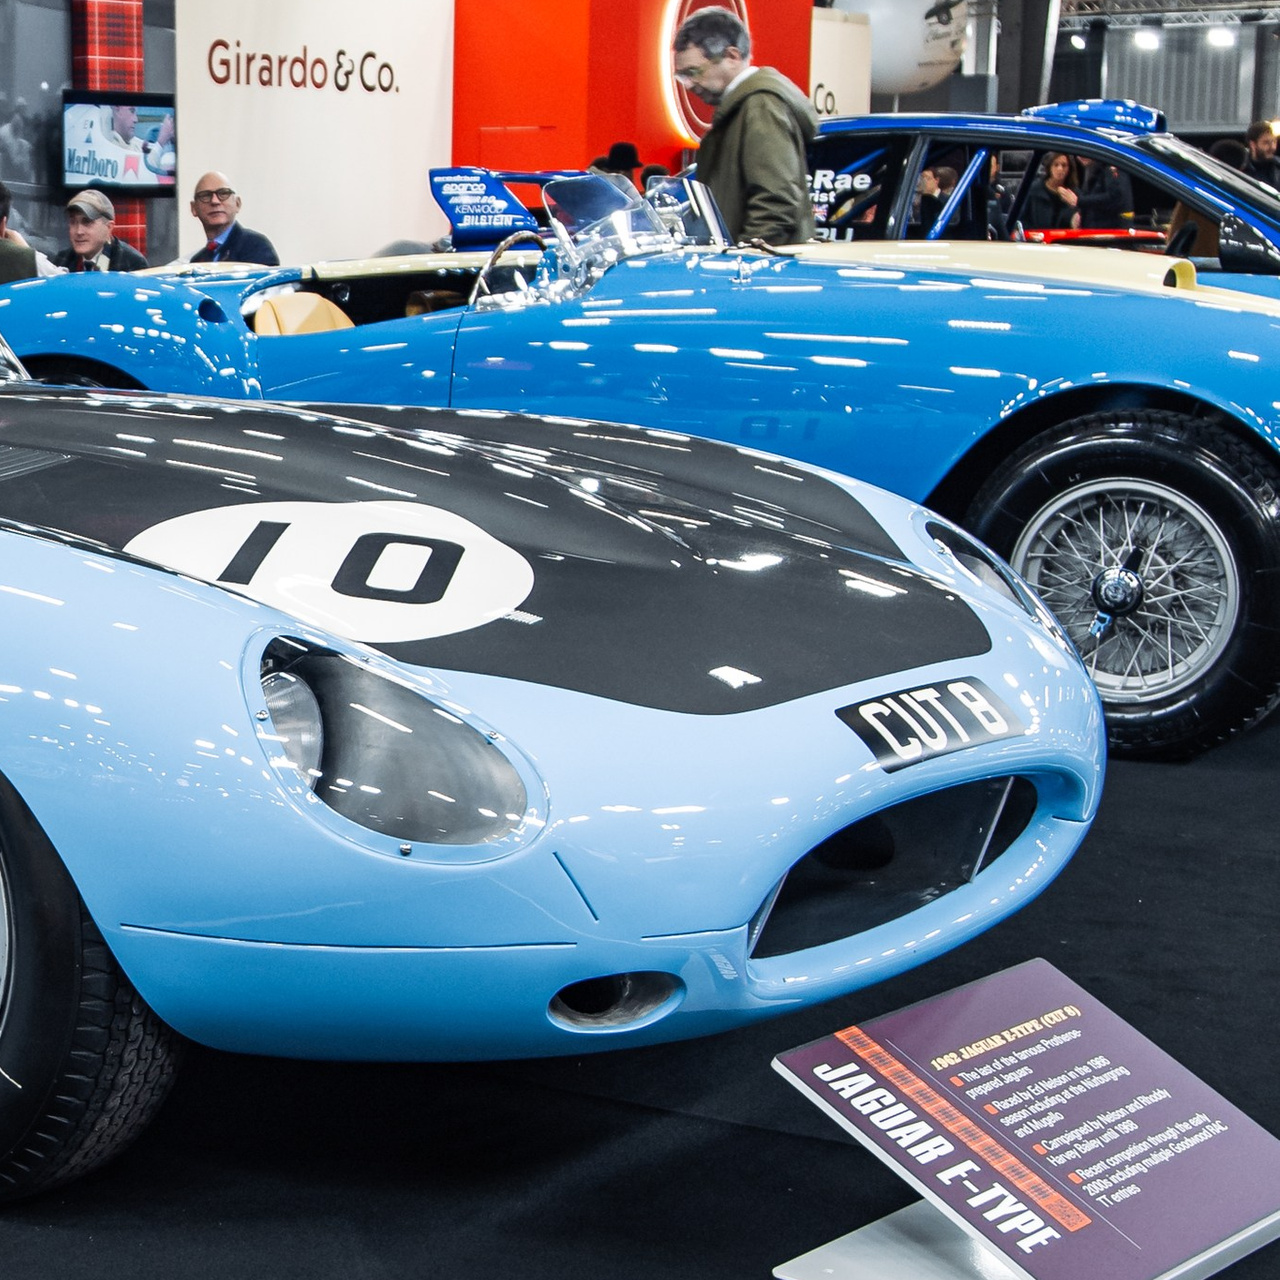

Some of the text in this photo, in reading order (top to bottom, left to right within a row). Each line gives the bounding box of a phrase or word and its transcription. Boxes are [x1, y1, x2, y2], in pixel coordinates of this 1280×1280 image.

[207, 39, 328, 90] Girardo
[814, 83, 839, 115] Co.
[65, 148, 119, 179] Marlboro
[805, 169, 872, 190] Rae
[442, 183, 487, 195] sparco
[809, 190, 837, 203] rist
[455, 205, 505, 214] KENWOOD
[463, 214, 513, 226] BILSTEIN
[1068, 472, 1081, 483] LF
[216, 519, 466, 605] 10
[858, 681, 1009, 760] CUT 8
[930, 1052, 963, 1071] 1962
[958, 1034, 1007, 1060] JAGUAR
[1000, 1018, 1044, 1042] E-TYPE
[1040, 1009, 1069, 1029] (CUT
[958, 1071, 982, 1083] The
[974, 1064, 997, 1077] last
[992, 1058, 1006, 1071] of
[1000, 1056, 1019, 1067] the
[1011, 1043, 1047, 1061] famous
[991, 1055, 1111, 1111] Raced by Ed Nelson in the 1966
[965, 1066, 1034, 1101] prepared Jaguars
[1000, 1108, 1033, 1127] season
[1024, 1094, 1068, 1116] including
[1061, 1088, 1075, 1100] at
[1068, 1083, 1088, 1096] the
[1013, 1111, 1065, 1138] and Mugello
[1041, 1088, 1173, 1151] Campaigned by Nelson and Rhoddy
[812, 1061, 1062, 1254] JAGUAR E-TYPE
[1045, 1119, 1140, 1168] Harvey Bailey until 1968
[1075, 1112, 1211, 1180] Recent competition through the early
[1082, 1120, 1229, 1197] 2000s including multiple Goodwood RAC
[1095, 1184, 1142, 1209] TT entries
